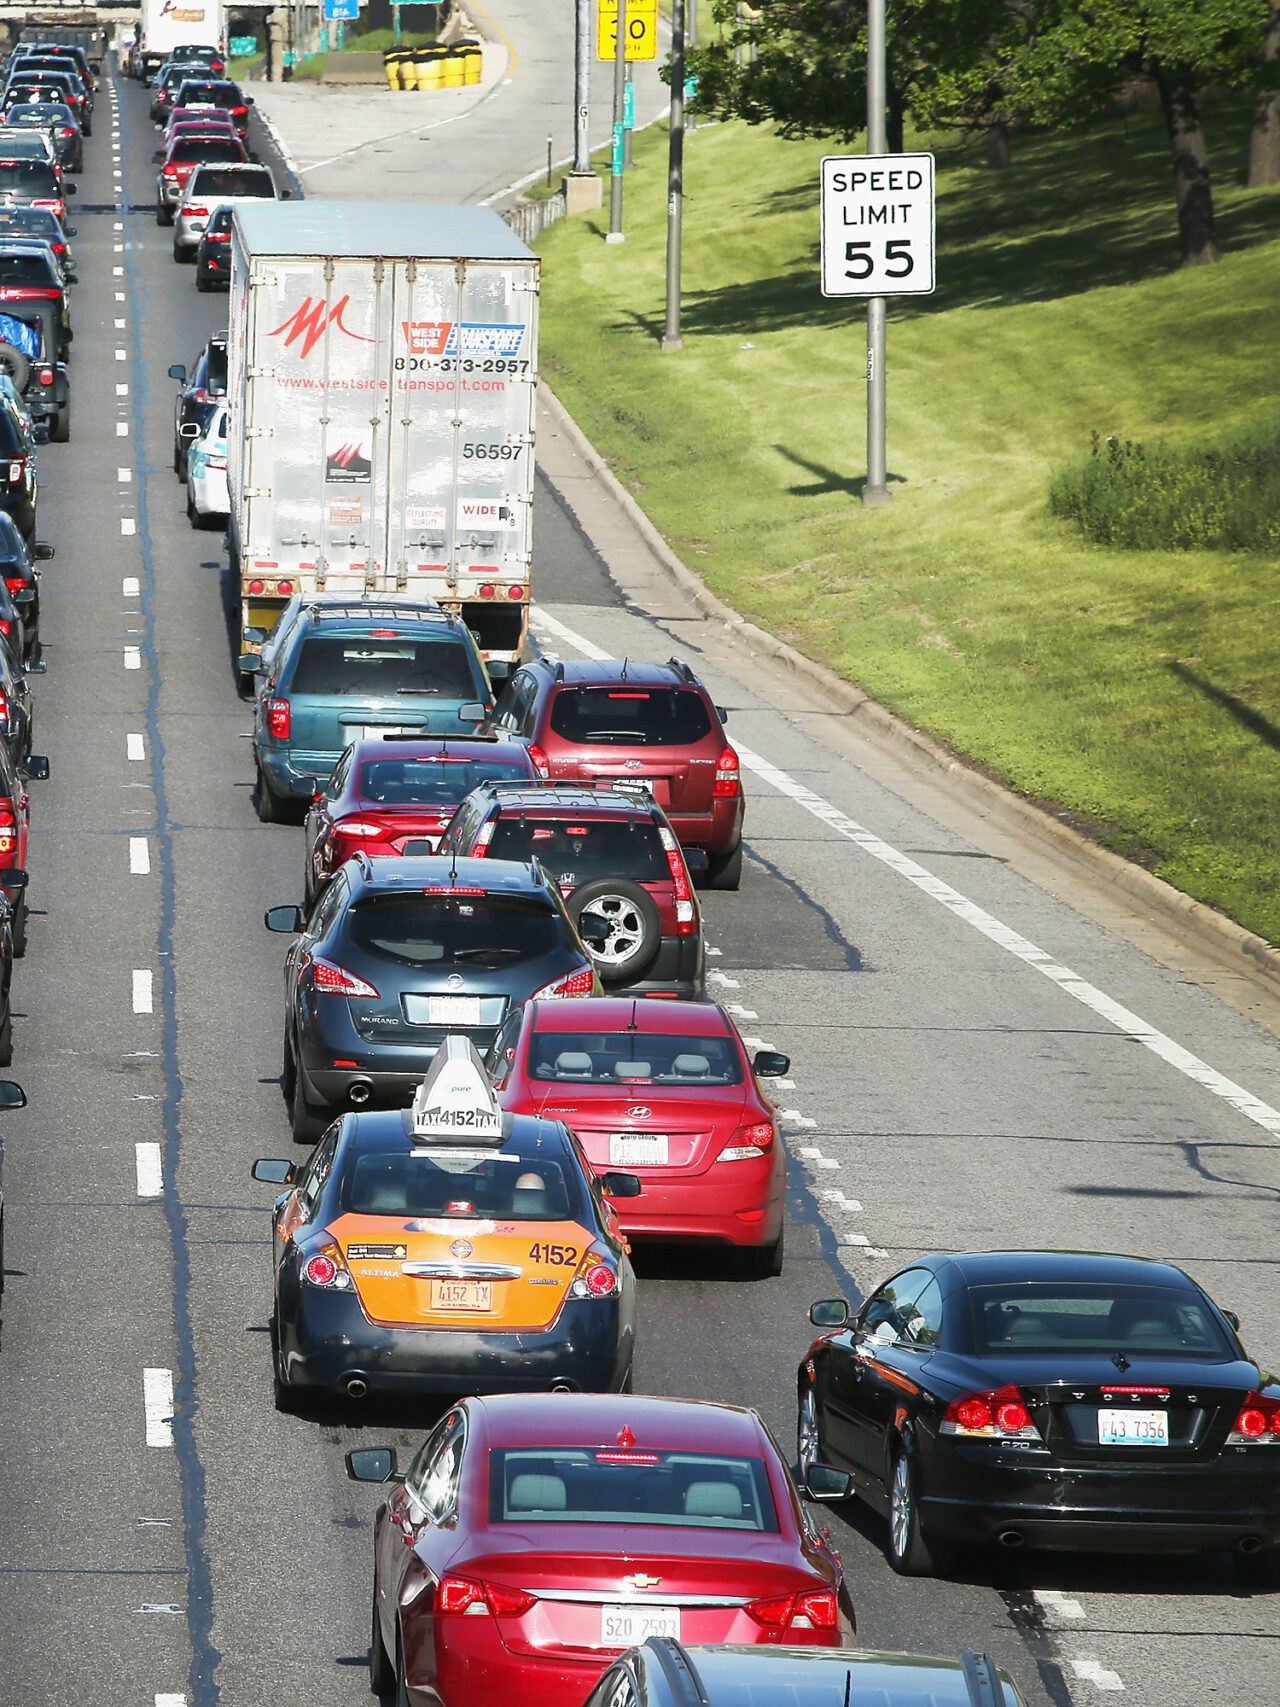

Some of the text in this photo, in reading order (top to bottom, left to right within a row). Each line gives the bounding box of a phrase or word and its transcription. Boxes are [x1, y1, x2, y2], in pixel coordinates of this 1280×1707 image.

[832, 170, 923, 192] SPEED
[843, 204, 912, 226] LIMIT
[844, 239, 914, 280] 55
[410, 327, 443, 338] WEST
[412, 338, 439, 348] SIDE
[462, 443, 523, 461] 56597
[462, 505, 497, 515] WIDE
[361, 1016, 399, 1025] MURANO
[417, 1110, 501, 1128] TAXI 4152 TAXI
[529, 1243, 578, 1267] 4152
[359, 1268, 401, 1278] ALTIMA
[438, 1286, 489, 1302] 4152 TX
[1102, 1421, 1165, 1439] F43 7356
[1000, 1441, 1030, 1450] C70
[606, 1617, 632, 1636] S20
